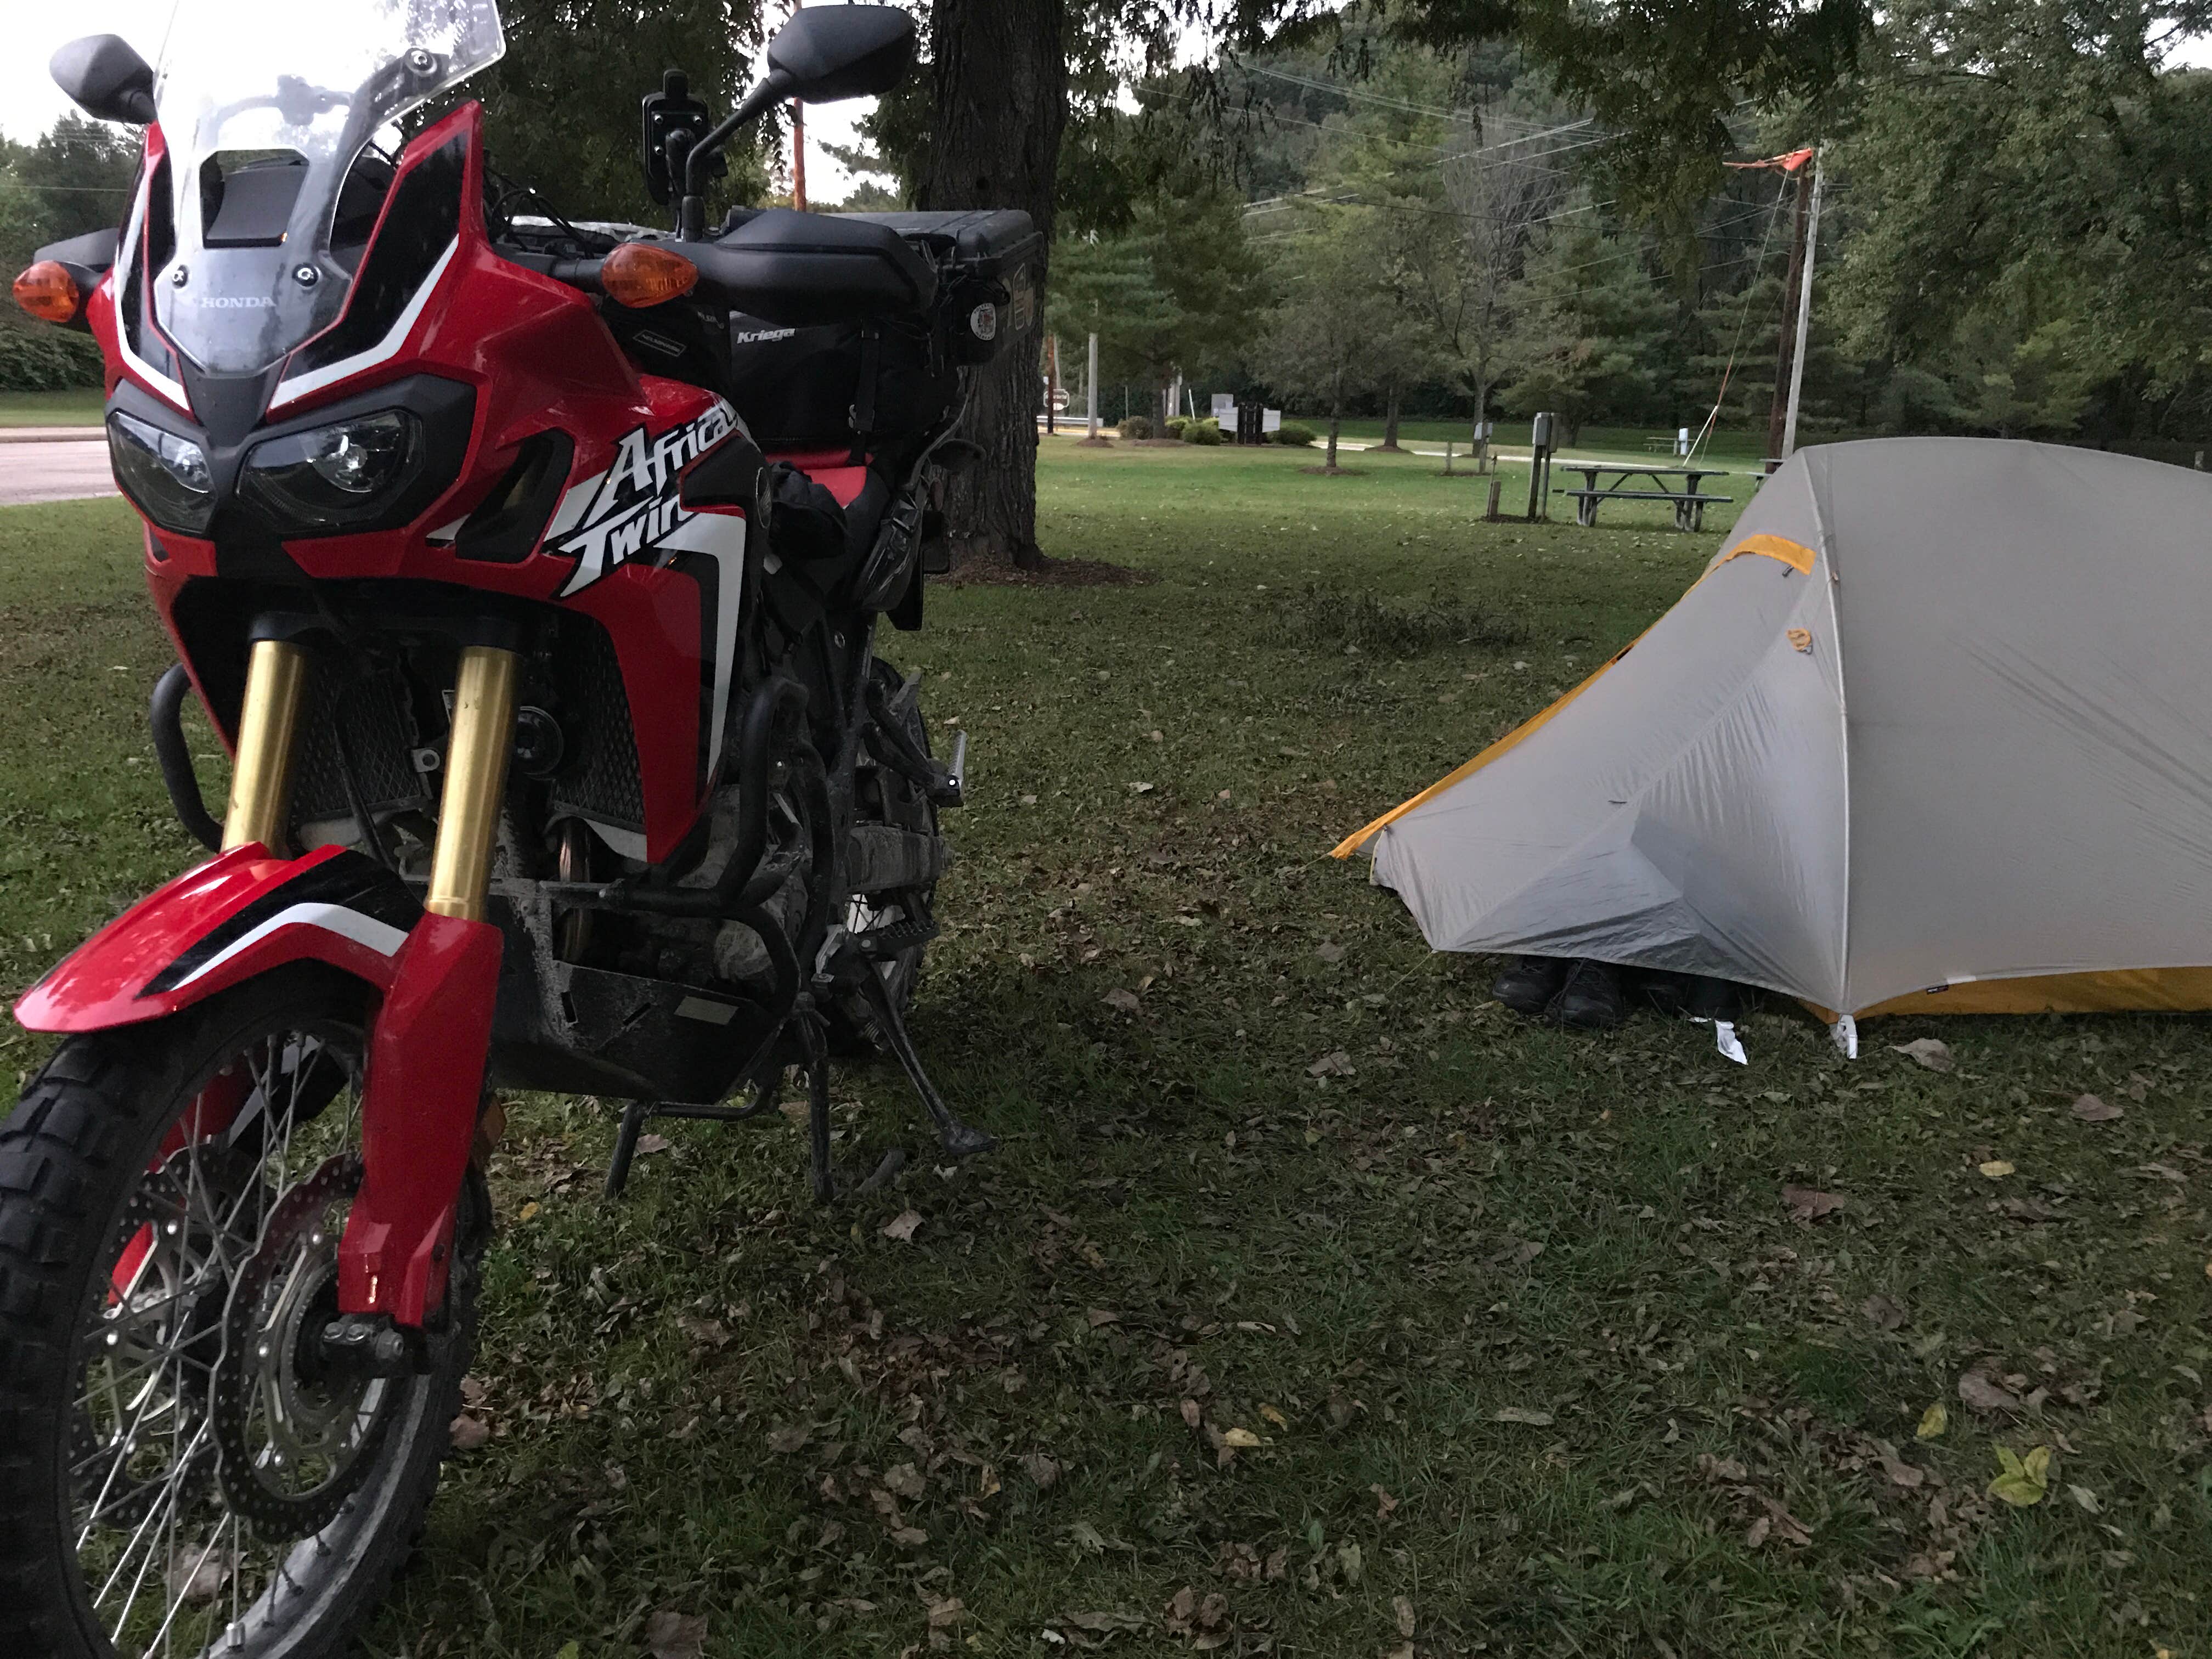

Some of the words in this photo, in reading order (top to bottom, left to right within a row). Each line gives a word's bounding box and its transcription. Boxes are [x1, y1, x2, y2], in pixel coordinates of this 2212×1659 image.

[201, 296, 276, 308] HONDA
[737, 328, 796, 344] Kriega
[583, 413, 738, 530] Africa
[558, 494, 695, 597] Twin
